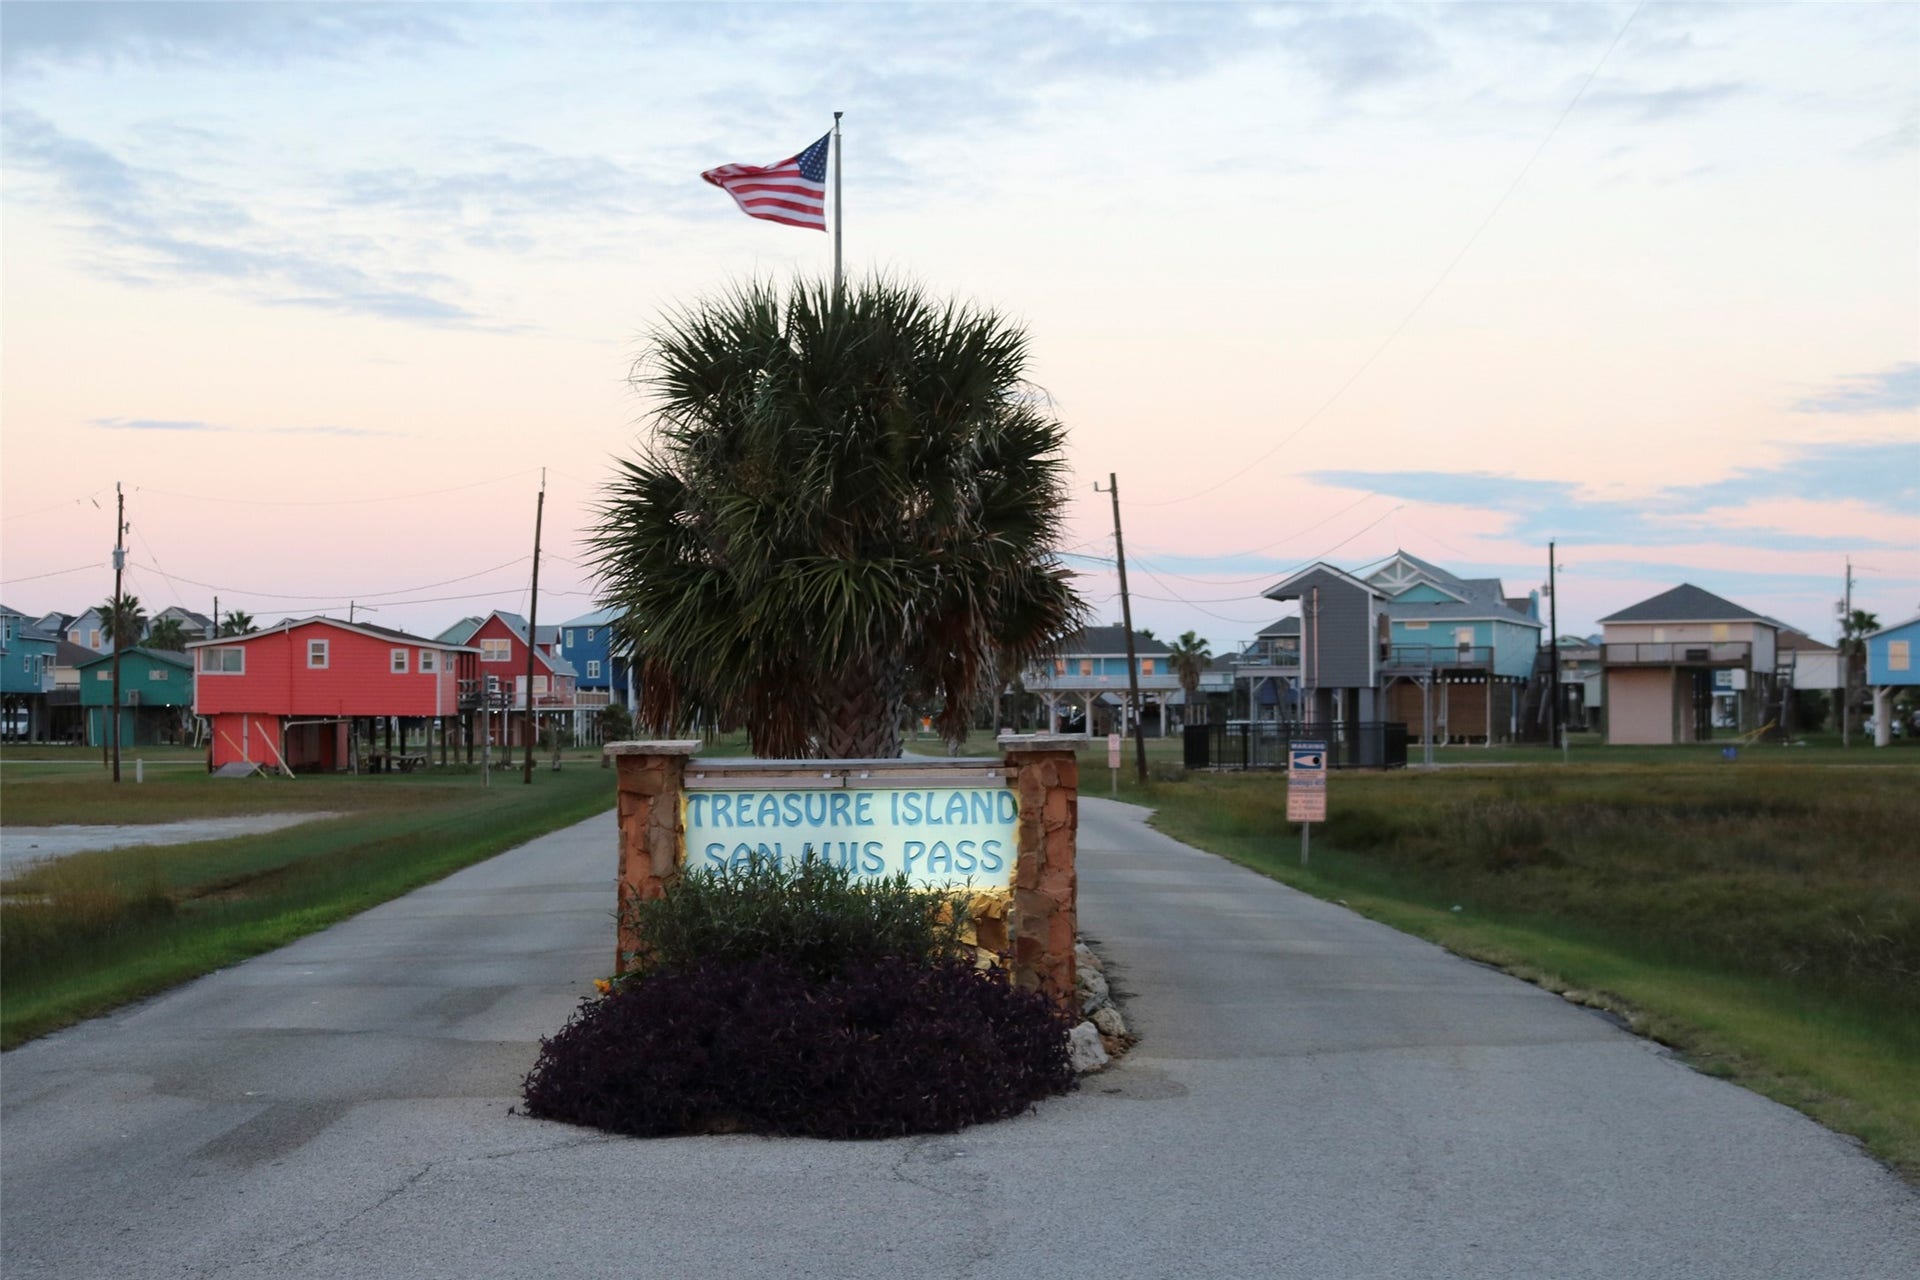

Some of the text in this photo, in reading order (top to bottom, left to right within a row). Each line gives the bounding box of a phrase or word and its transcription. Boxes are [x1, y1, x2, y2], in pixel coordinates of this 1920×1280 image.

[687, 791, 1018, 827] TREASURE ISLAND
[704, 841, 782, 876] SAN
[903, 840, 1003, 874] PASS
